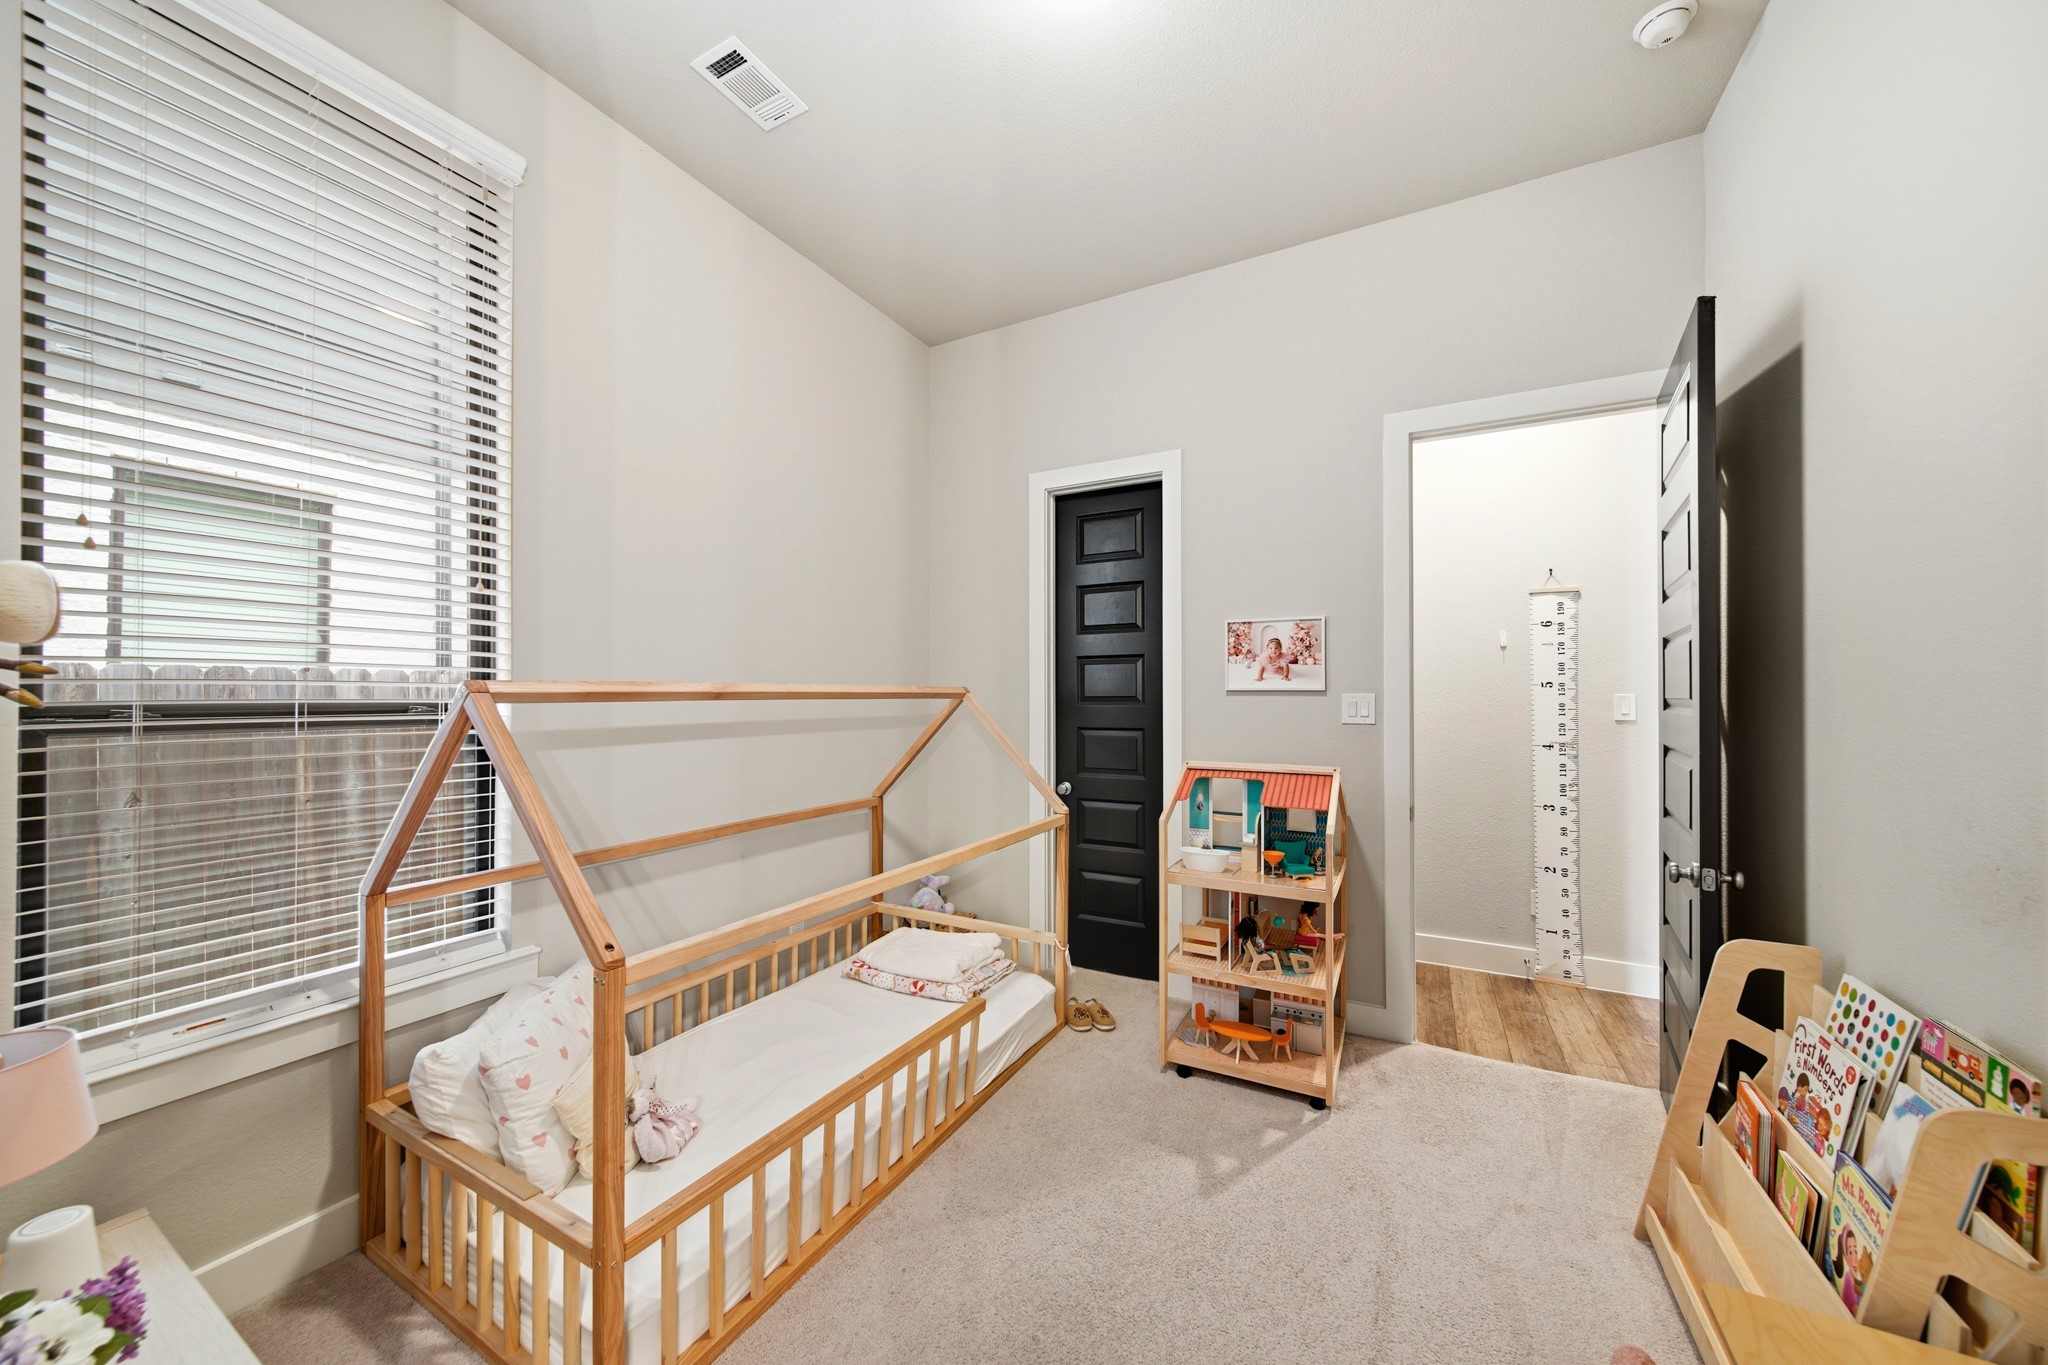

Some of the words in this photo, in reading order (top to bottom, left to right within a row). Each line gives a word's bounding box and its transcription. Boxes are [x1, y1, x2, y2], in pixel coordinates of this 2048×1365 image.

[1557, 601, 1565, 615] 190
[1540, 620, 1552, 628] 6
[1557, 622, 1565, 636] 180
[1541, 681, 1553, 689] 5
[1558, 702, 1566, 716] 140
[1559, 763, 1567, 777] 110
[1559, 783, 1567, 797] 100
[1543, 804, 1555, 812] 3
[1560, 806, 1567, 816] 90
[1560, 827, 1568, 836] 80
[1561, 847, 1568, 856] 70
[1544, 866, 1556, 874] 2
[1561, 868, 1568, 877] 60
[1561, 888, 1569, 898] 50
[1562, 909, 1569, 918] 40
[1562, 930, 1570, 939] 30
[1563, 950, 1570, 959] 20
[1563, 970, 1571, 979] 10
[1794, 1037, 1817, 1059] First
[1817, 1048, 1847, 1096] Words
[1796, 1056, 1802, 1068] &
[1802, 1058, 1836, 1101] Numbers
[1842, 1173, 1856, 1199] Ms.
